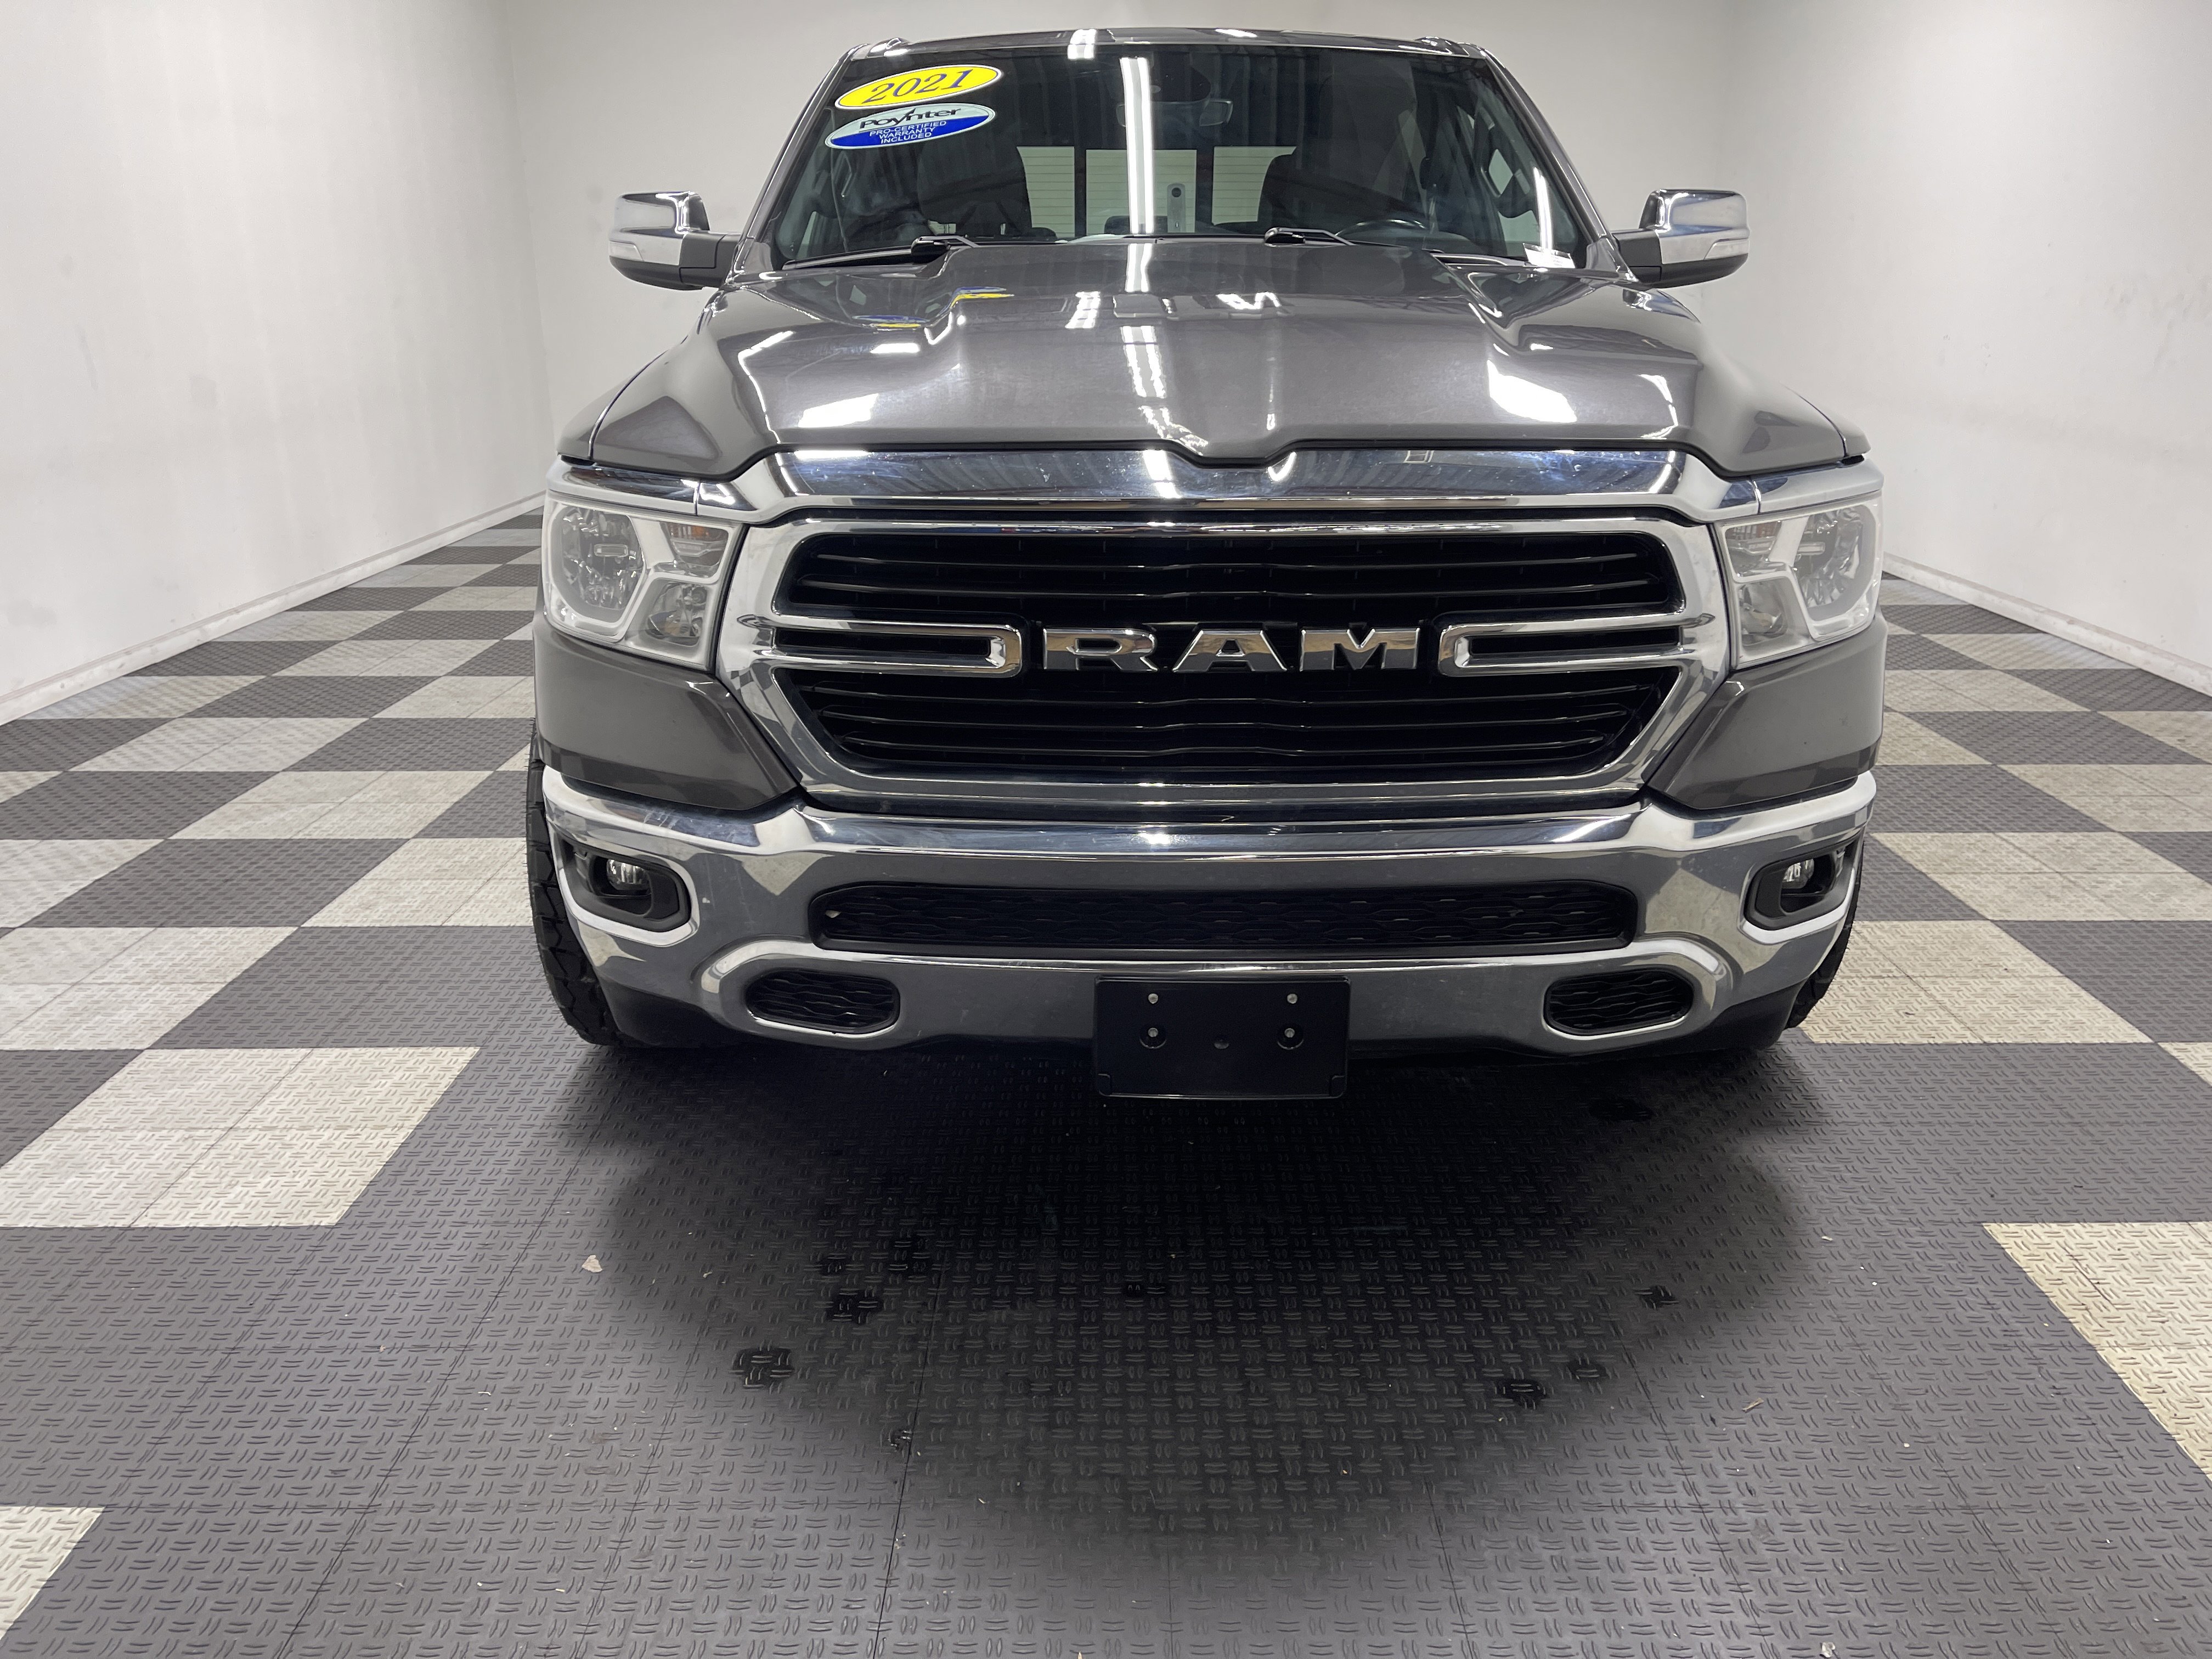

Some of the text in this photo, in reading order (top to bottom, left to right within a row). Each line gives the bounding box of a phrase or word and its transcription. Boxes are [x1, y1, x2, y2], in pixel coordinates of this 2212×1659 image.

[861, 69, 973, 104] 2021
[859, 108, 961, 130] Poynter
[870, 121, 946, 137] PRO-CERTIFIED
[879, 127, 936, 139] WARRANTY
[881, 132, 932, 144] INCLUDED
[1043, 628, 1420, 673] RAM
